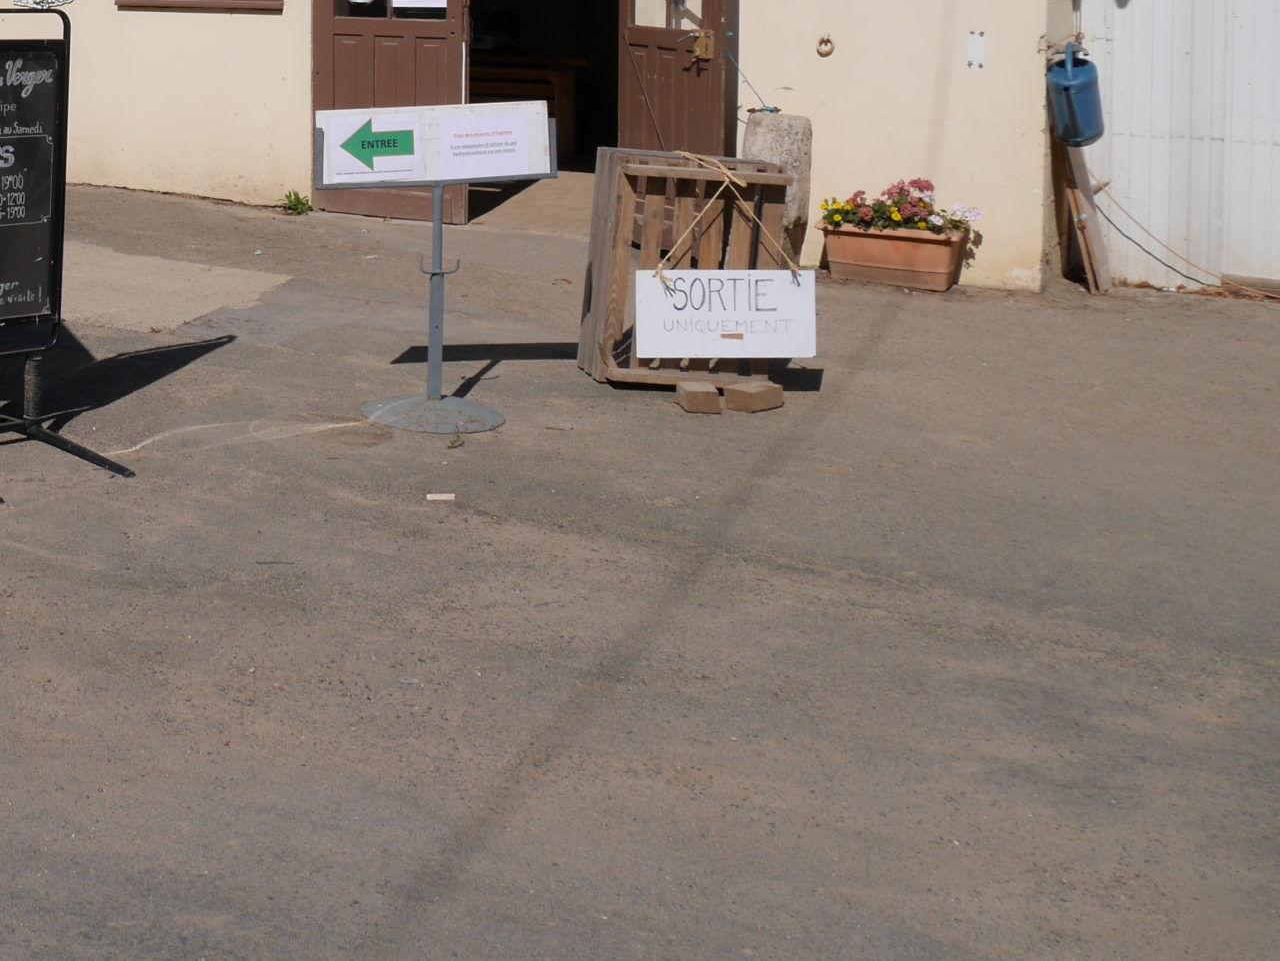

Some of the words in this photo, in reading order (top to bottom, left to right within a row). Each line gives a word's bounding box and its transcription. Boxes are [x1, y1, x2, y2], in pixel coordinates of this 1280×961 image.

[6, 58, 53, 98] Verger
[3, 126, 12, 134] au
[361, 138, 399, 149] ENTREE
[7, 289, 35, 303] visite
[673, 273, 778, 312] SORTIE
[663, 316, 794, 336] UNIQUEMENT
